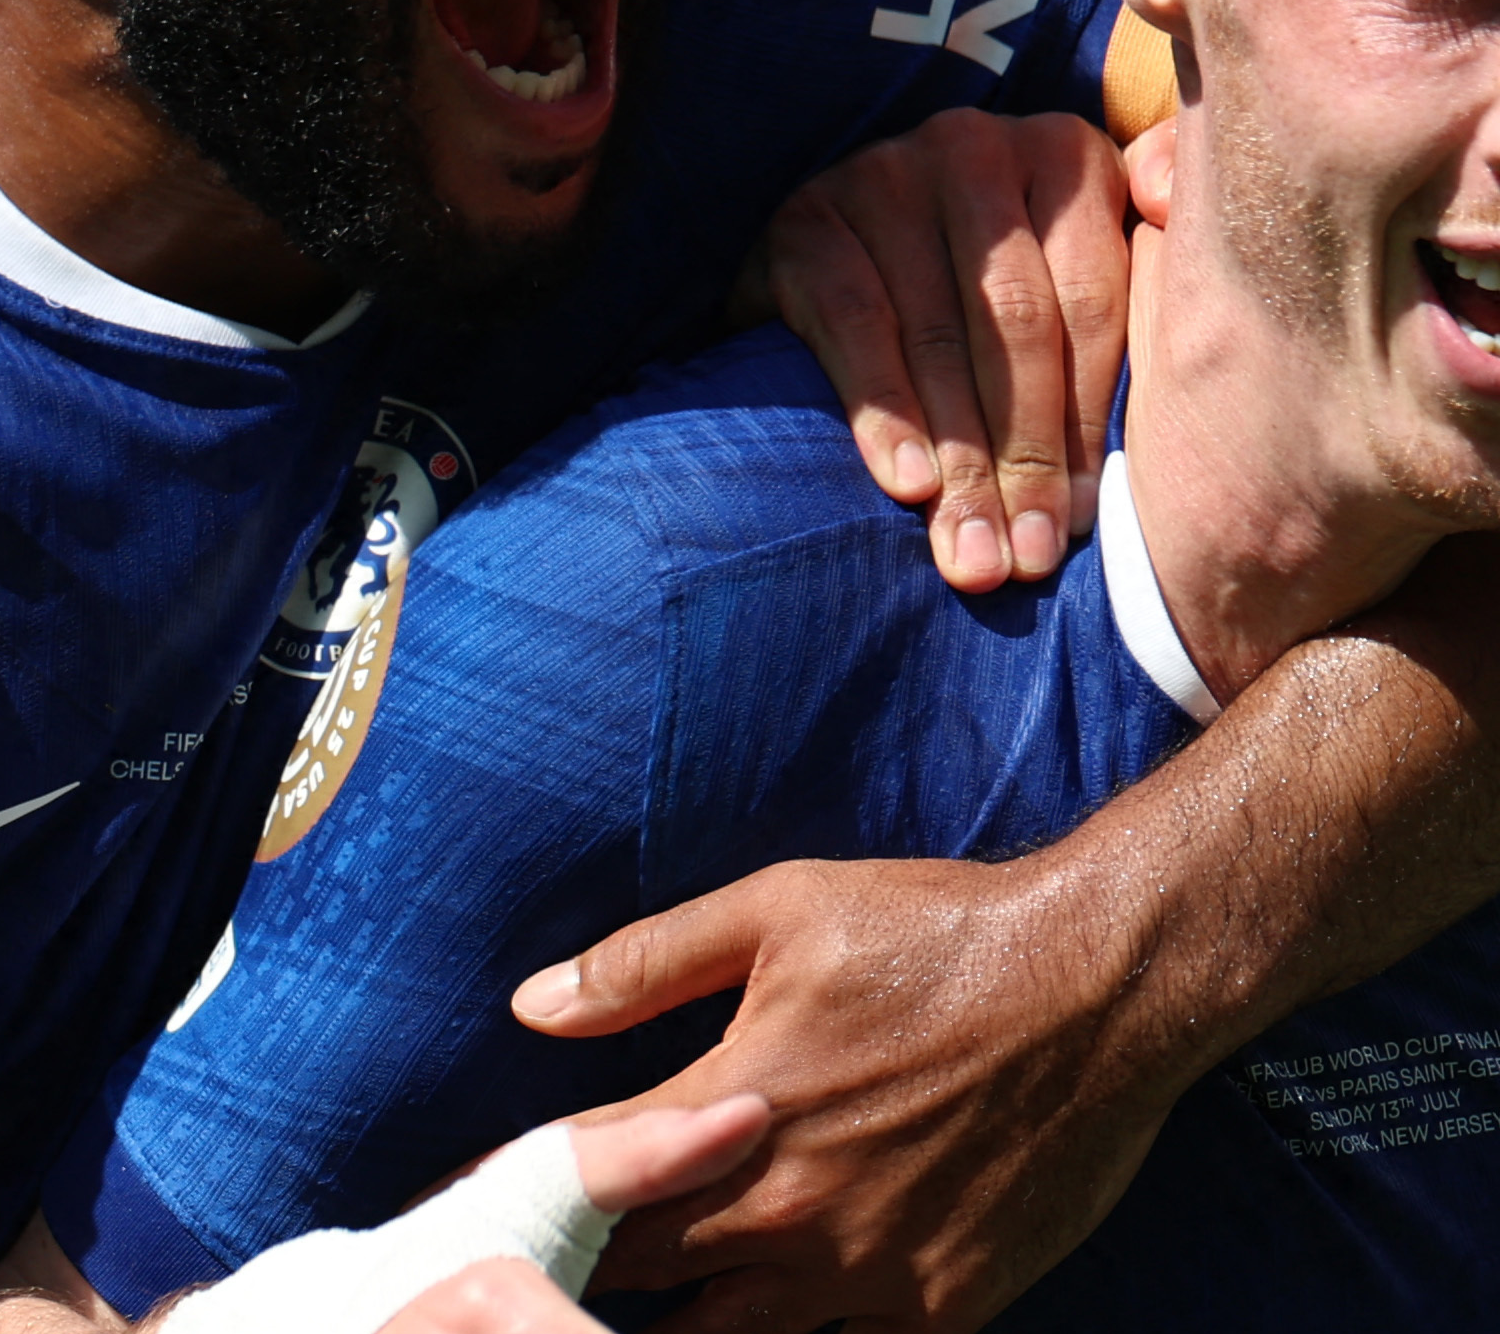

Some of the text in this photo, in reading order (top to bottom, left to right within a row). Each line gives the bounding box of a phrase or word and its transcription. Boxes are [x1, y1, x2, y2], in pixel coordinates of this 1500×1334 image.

[275, 637, 344, 663] FOOTB
[354, 619, 381, 692] CUP
[327, 707, 356, 757] 25
[110, 759, 186, 782] CHEL
[284, 760, 325, 819] USA
[1244, 1063, 1277, 1083] IFA
[1328, 1042, 1400, 1072] WORLD
[1404, 1034, 1452, 1057] CUP
[1340, 1071, 1400, 1099] PARIS
[1310, 1088, 1462, 1131] SUNDAY 13TH JULY
[1284, 1138, 1326, 1158] EW
[1380, 1123, 1430, 1149] NEW
